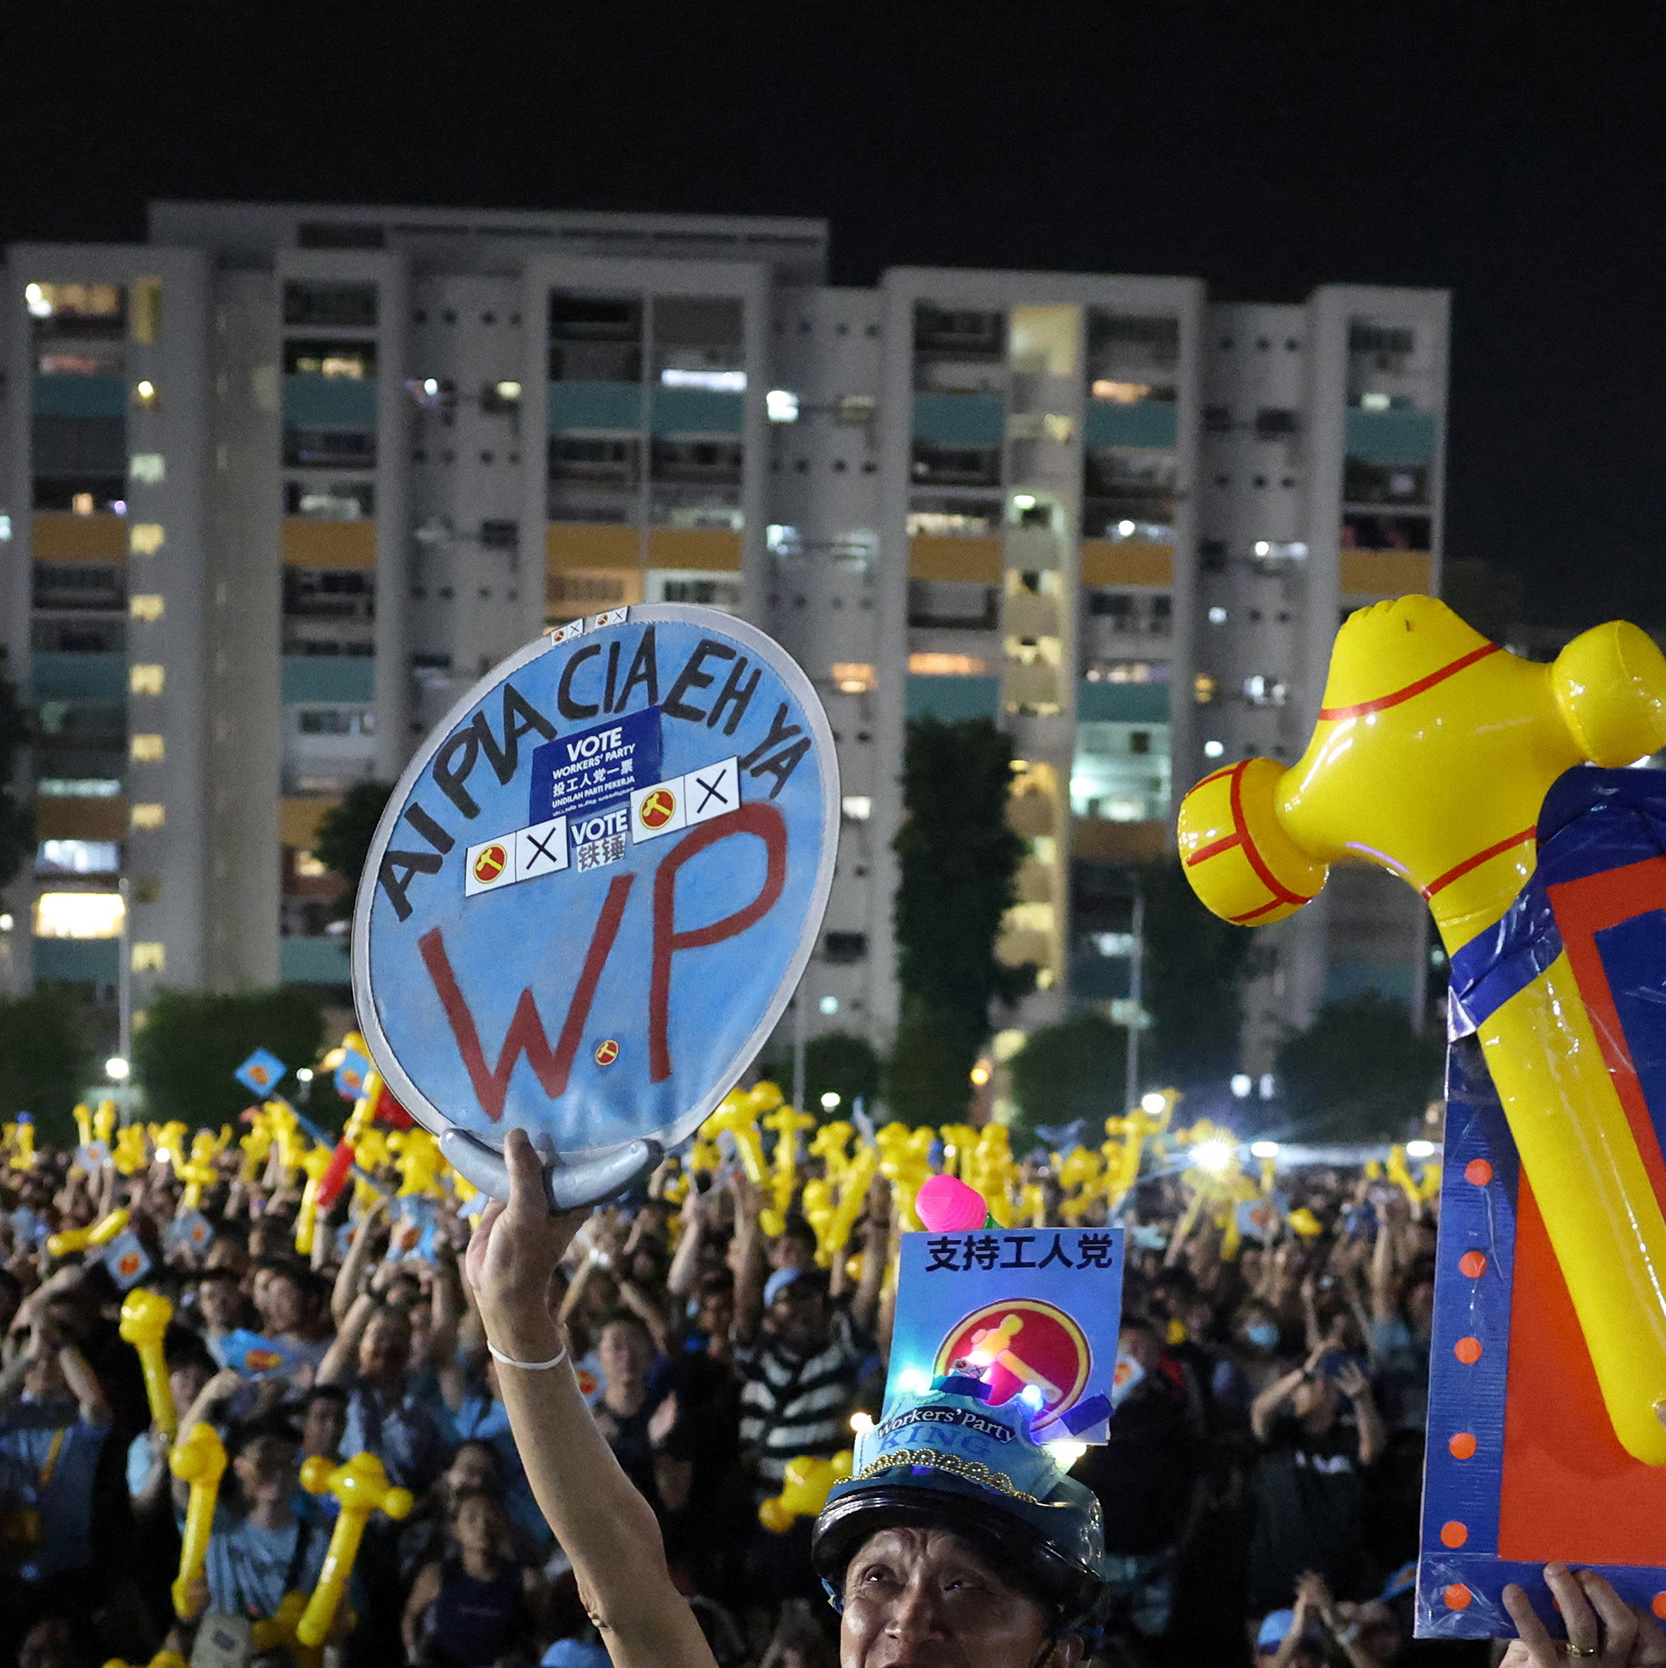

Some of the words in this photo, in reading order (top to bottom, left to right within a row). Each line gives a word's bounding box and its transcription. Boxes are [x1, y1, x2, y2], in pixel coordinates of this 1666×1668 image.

[552, 754, 604, 780] WORKERS'
[605, 743, 636, 762] PARTY
[566, 726, 623, 762] VOTE
[552, 758, 634, 798] 投工人党一票
[552, 791, 584, 808] UNDILAH
[584, 785, 604, 800] PARTI
[604, 776, 636, 791] PEKERJA
[376, 801, 456, 922] AI
[736, 702, 812, 800] YA
[570, 808, 629, 845] VOTE
[418, 801, 788, 1122] WP
[925, 1233, 1113, 1273] 支持工人党
[877, 1425, 992, 1454] KING
[878, 1408, 961, 1438] Workers'
[961, 1412, 1017, 1444] Party
